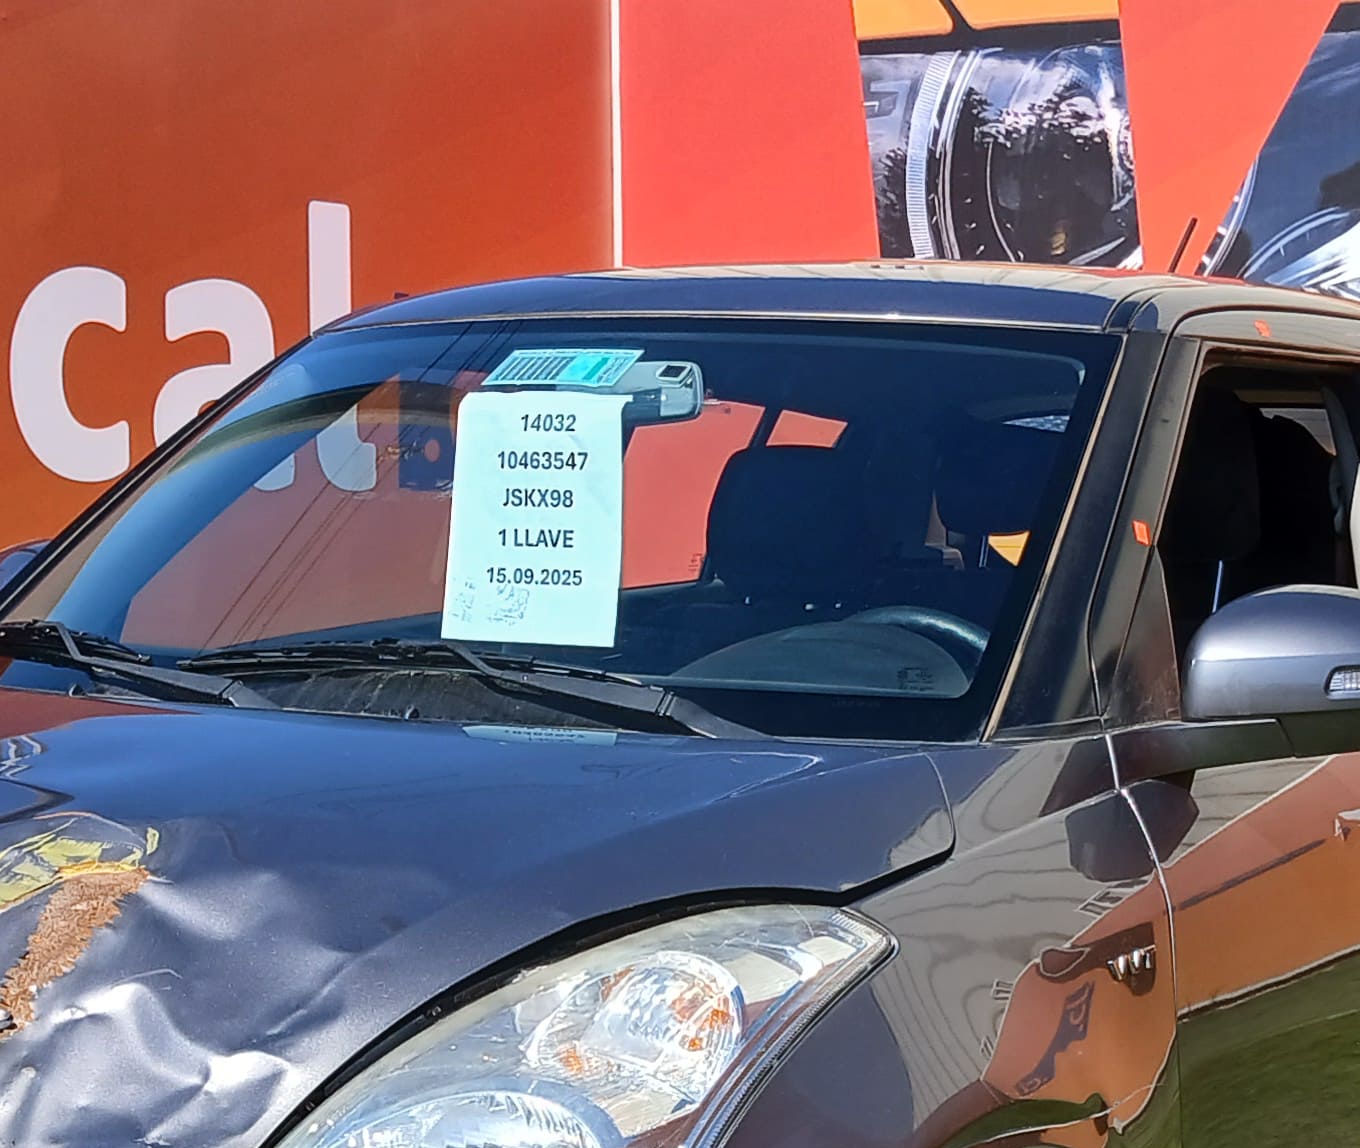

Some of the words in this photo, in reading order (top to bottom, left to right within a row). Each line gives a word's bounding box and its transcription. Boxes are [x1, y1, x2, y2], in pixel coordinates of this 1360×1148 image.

[520, 413, 577, 432] 14032
[497, 451, 589, 471] 10463547
[502, 488, 574, 509] JSKX98
[497, 528, 507, 547] 1
[513, 529, 575, 549] LLAVE
[486, 566, 583, 587] 15.09.2025
